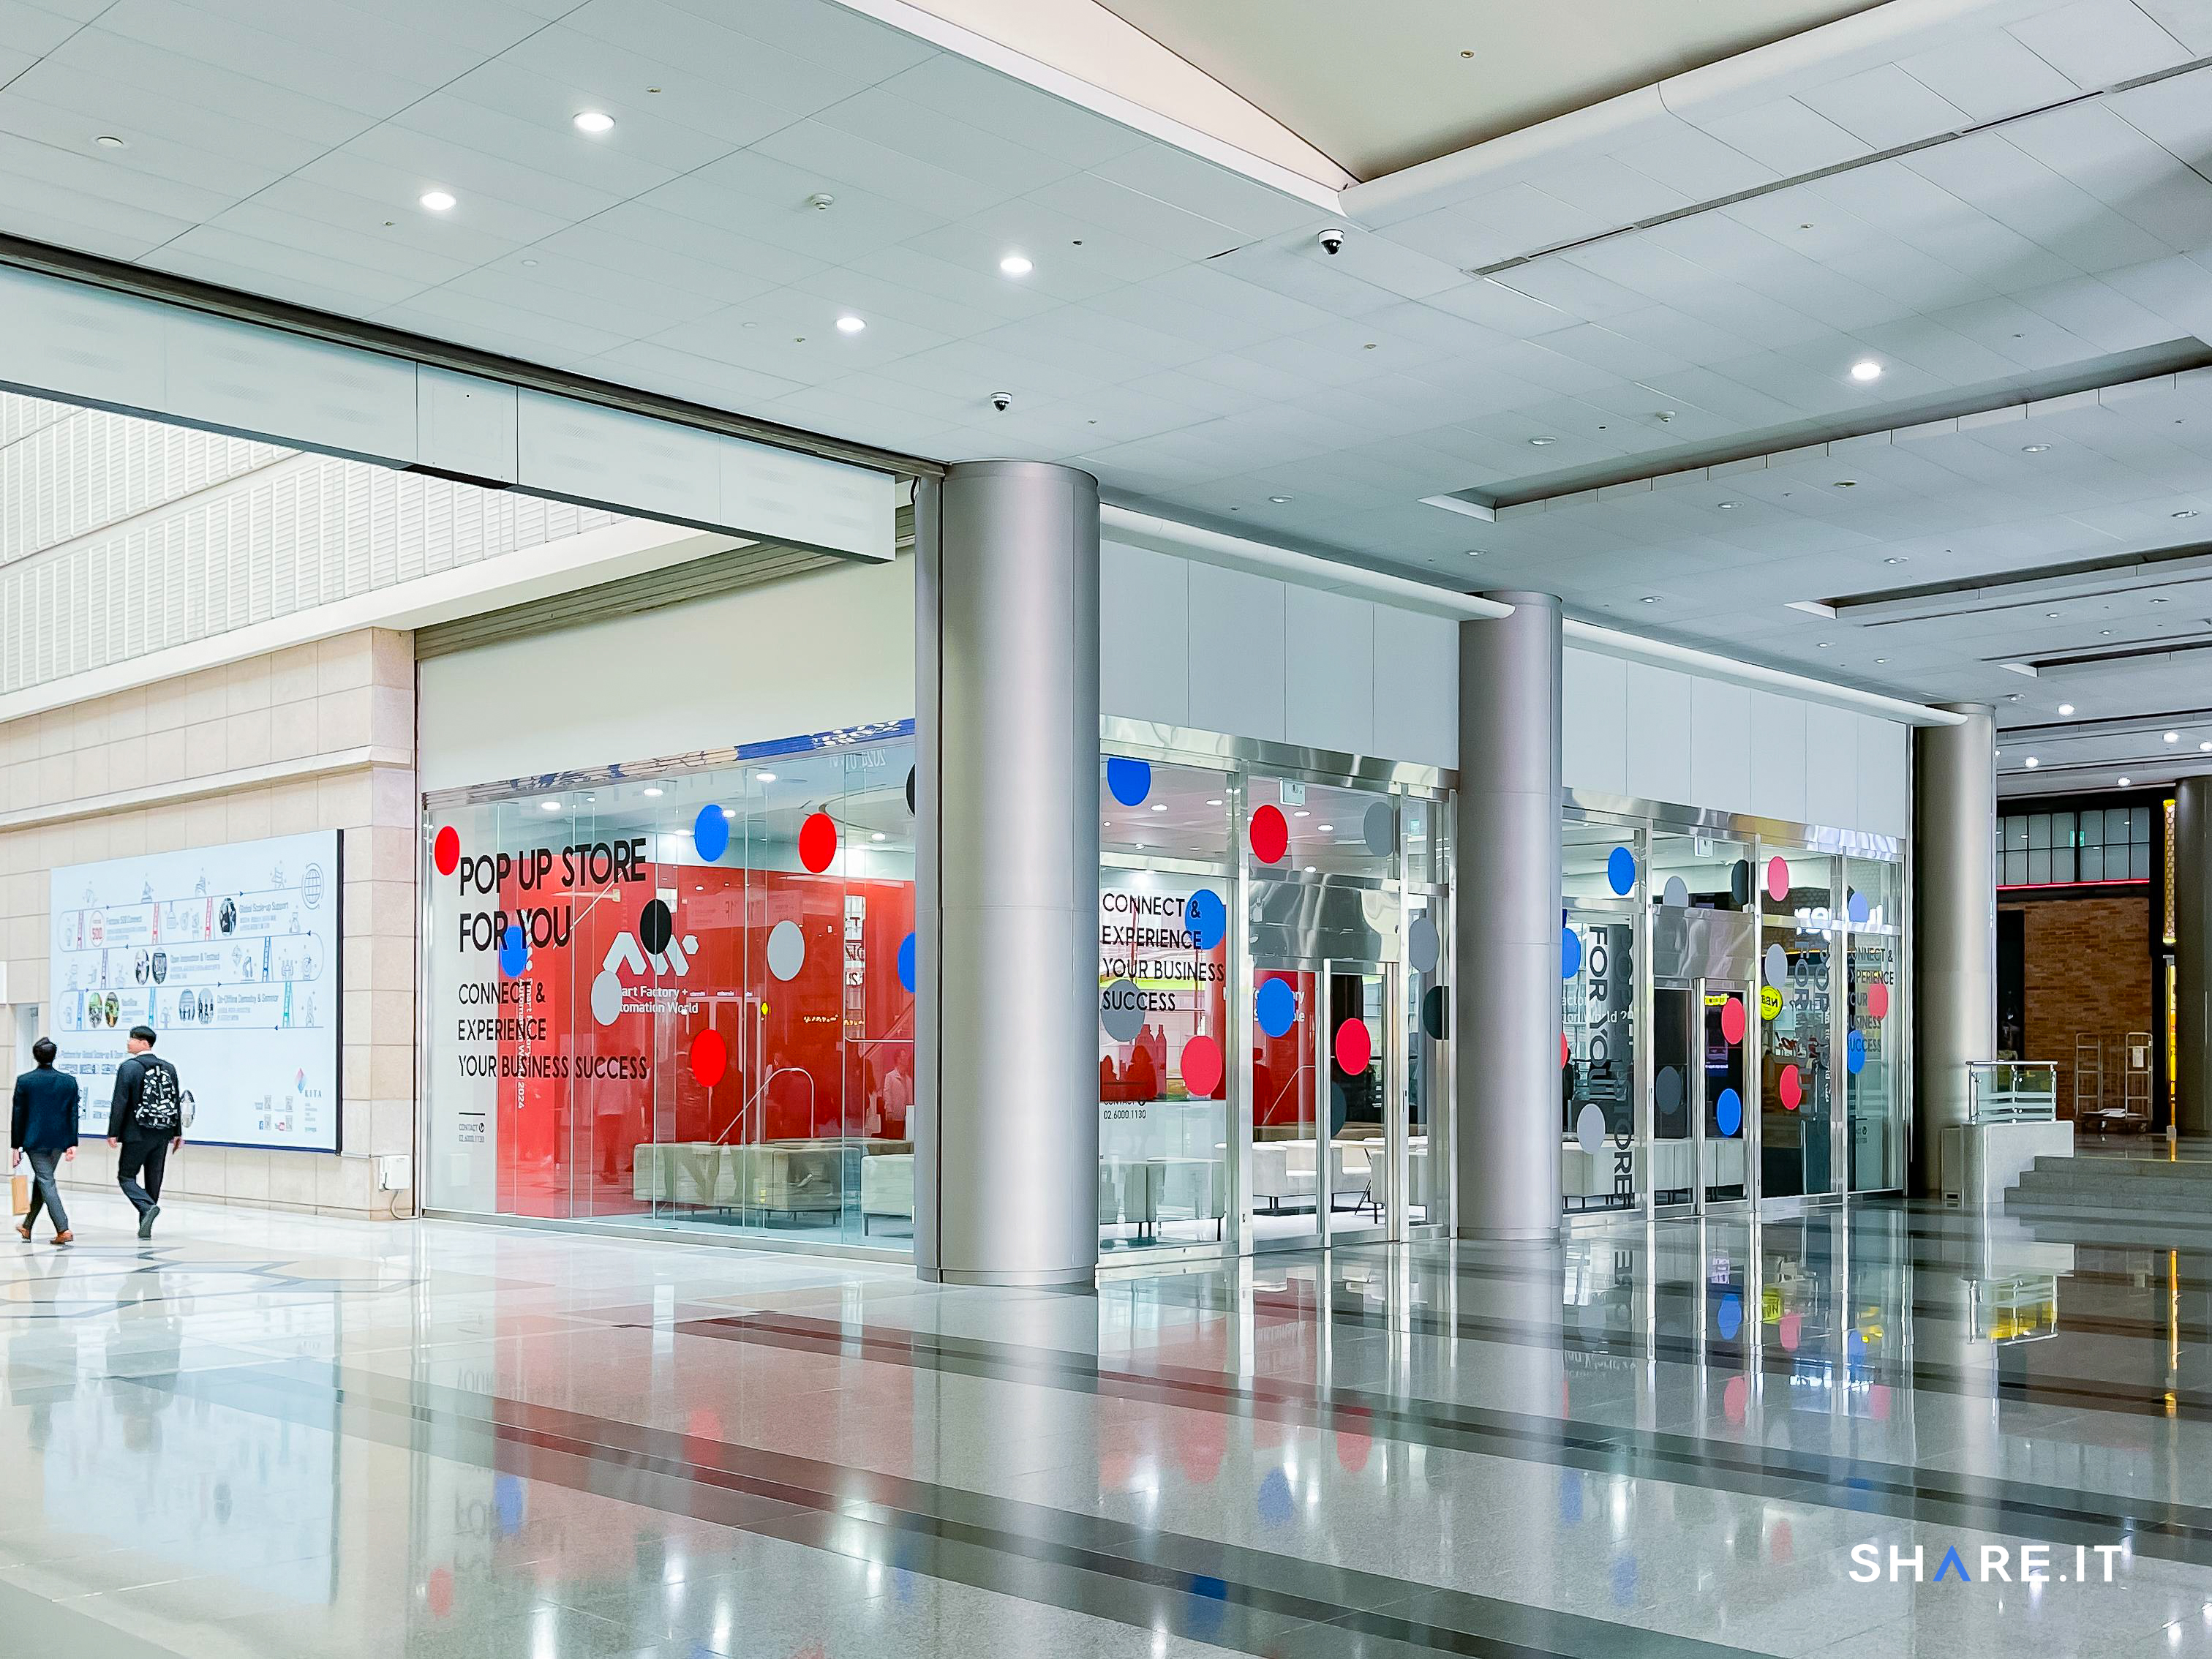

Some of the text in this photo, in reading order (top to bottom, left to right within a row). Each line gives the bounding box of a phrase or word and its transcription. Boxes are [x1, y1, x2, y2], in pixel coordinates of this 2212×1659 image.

[459, 838, 646, 896] POP UP STORE
[1102, 893, 1201, 919] CONNECT &
[459, 905, 571, 952] FOR YOU
[1102, 925, 1202, 949] EXPERIENCE
[1851, 947, 1894, 963] ONNECT &
[1102, 958, 1224, 982] YOUR BUSINESS
[1849, 969, 1894, 985] XPERIENCE
[459, 981, 546, 1005] CONNECT &
[622, 986, 638, 997] art
[640, 985, 680, 1000] Factory
[1102, 990, 1175, 1011] SUCCESS
[620, 1001, 699, 1015] tomation World
[1588, 925, 1608, 1094] FOR YOU
[458, 1017, 546, 1041] EXPERIENCE
[1850, 1015, 1881, 1029] USINESS
[1850, 1038, 1881, 1053] UCCESS
[459, 1055, 647, 1080] YOUR BUSINESS SUCCESS
